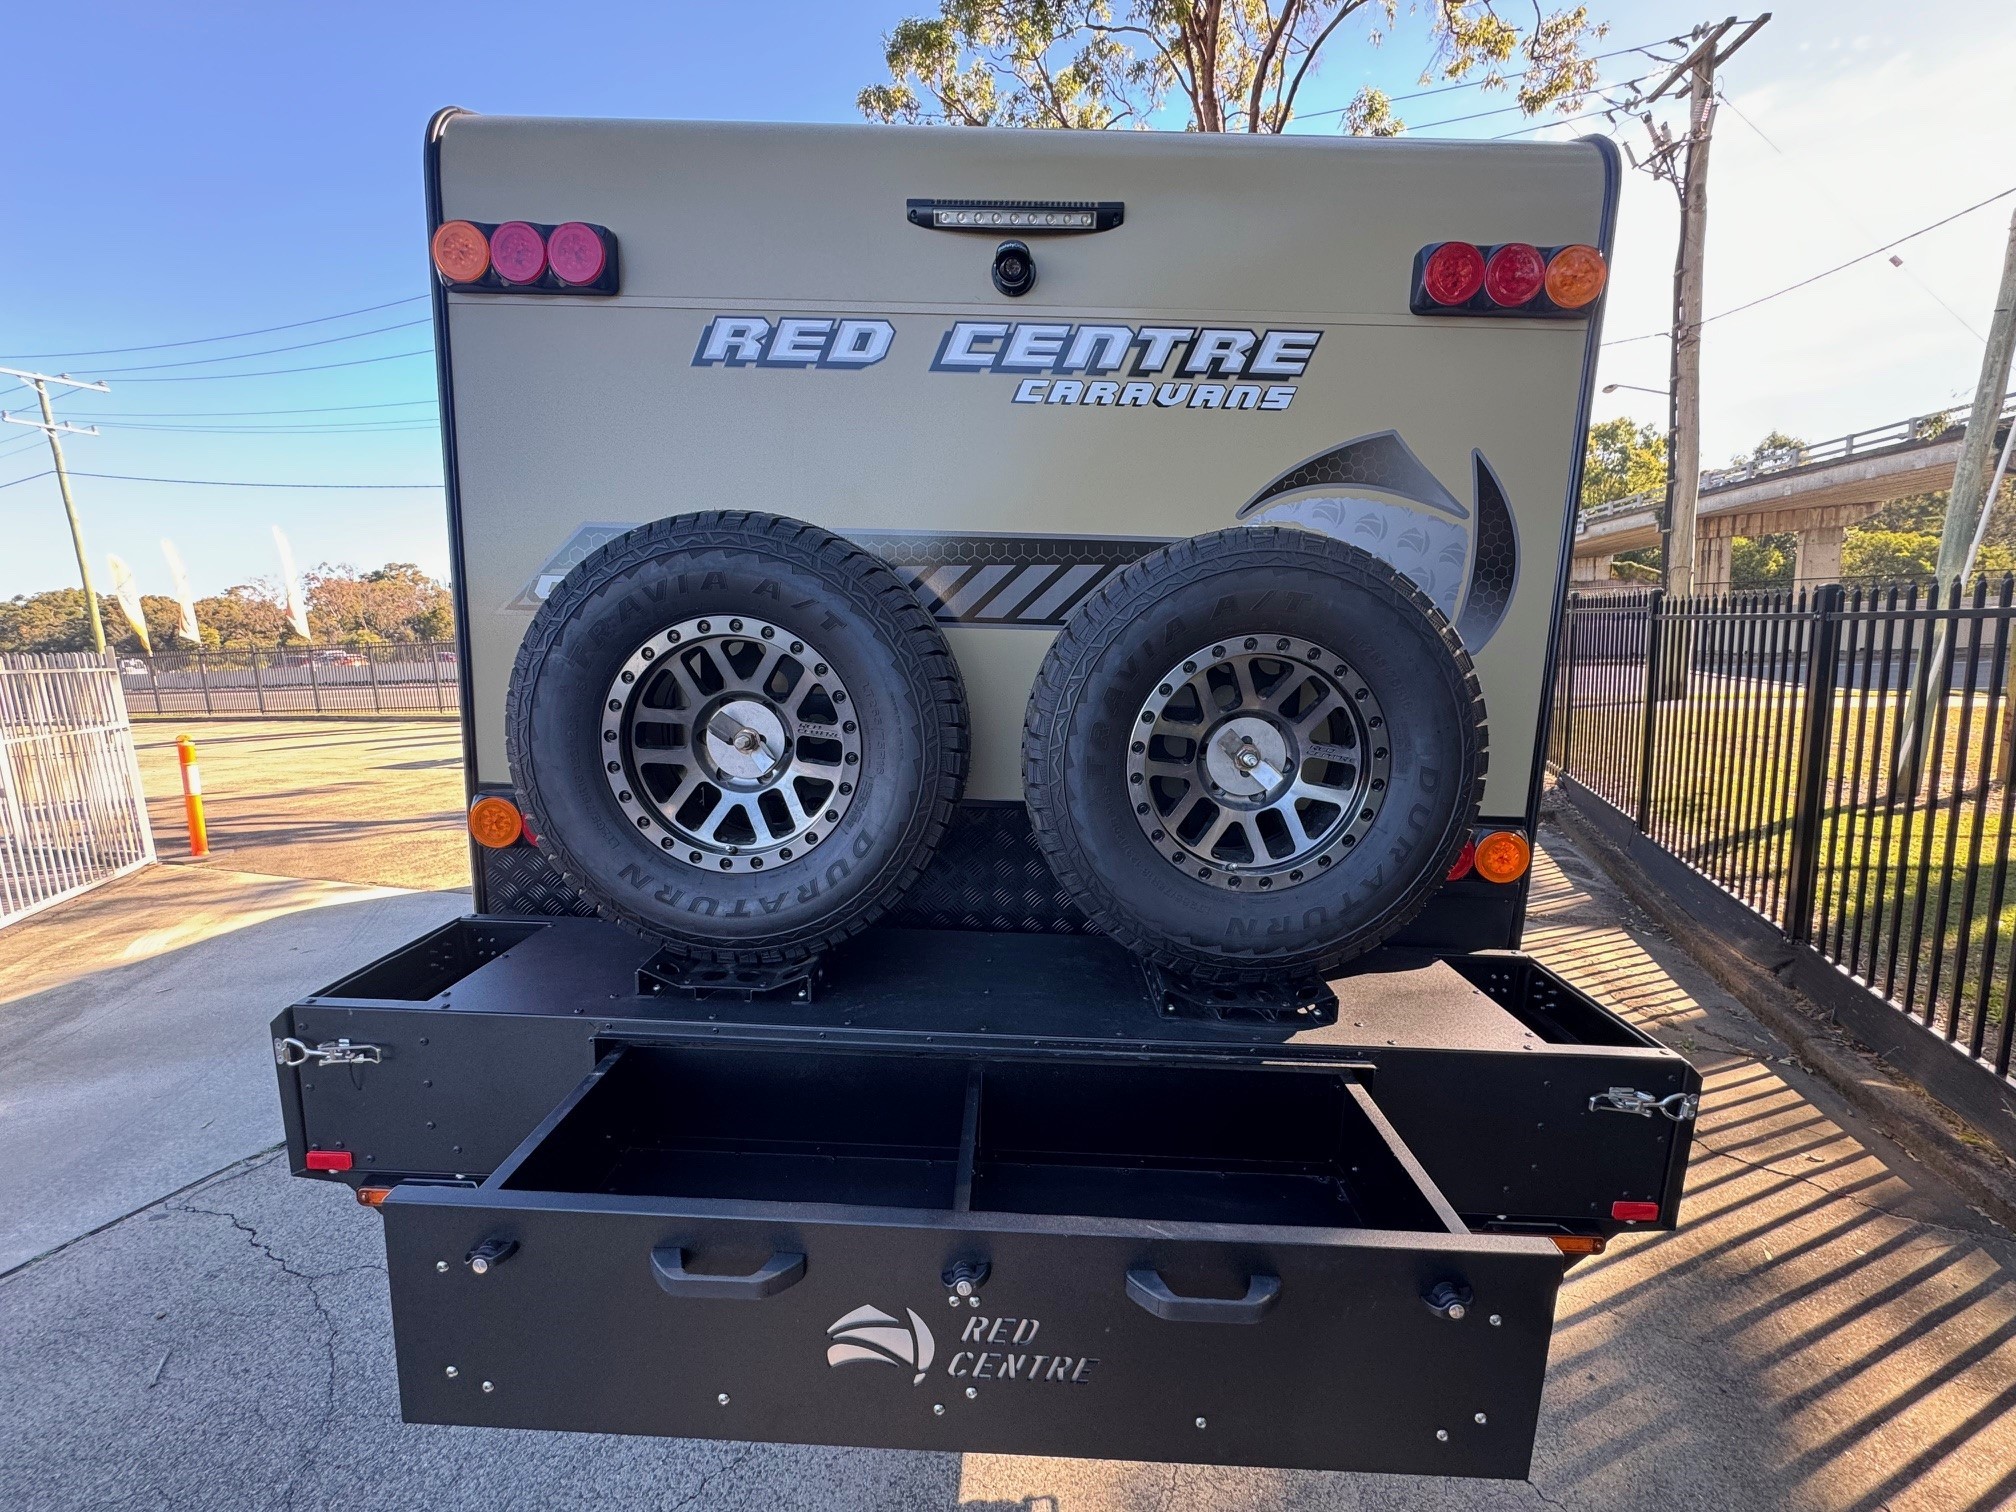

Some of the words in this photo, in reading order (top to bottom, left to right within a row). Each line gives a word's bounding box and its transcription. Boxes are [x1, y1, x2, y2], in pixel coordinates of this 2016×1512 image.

[692, 316, 896, 370] RED
[930, 321, 1325, 380] CENTRE
[1010, 379, 1298, 411] CARAVANS
[567, 571, 729, 669] TRAVIA
[751, 571, 849, 632] A/T
[1209, 588, 1315, 620] A/T
[617, 829, 876, 918] DURATURN
[1224, 766, 1440, 938] DURATURN
[961, 1316, 1040, 1346] RED
[948, 1351, 1100, 1385] CENTRE
